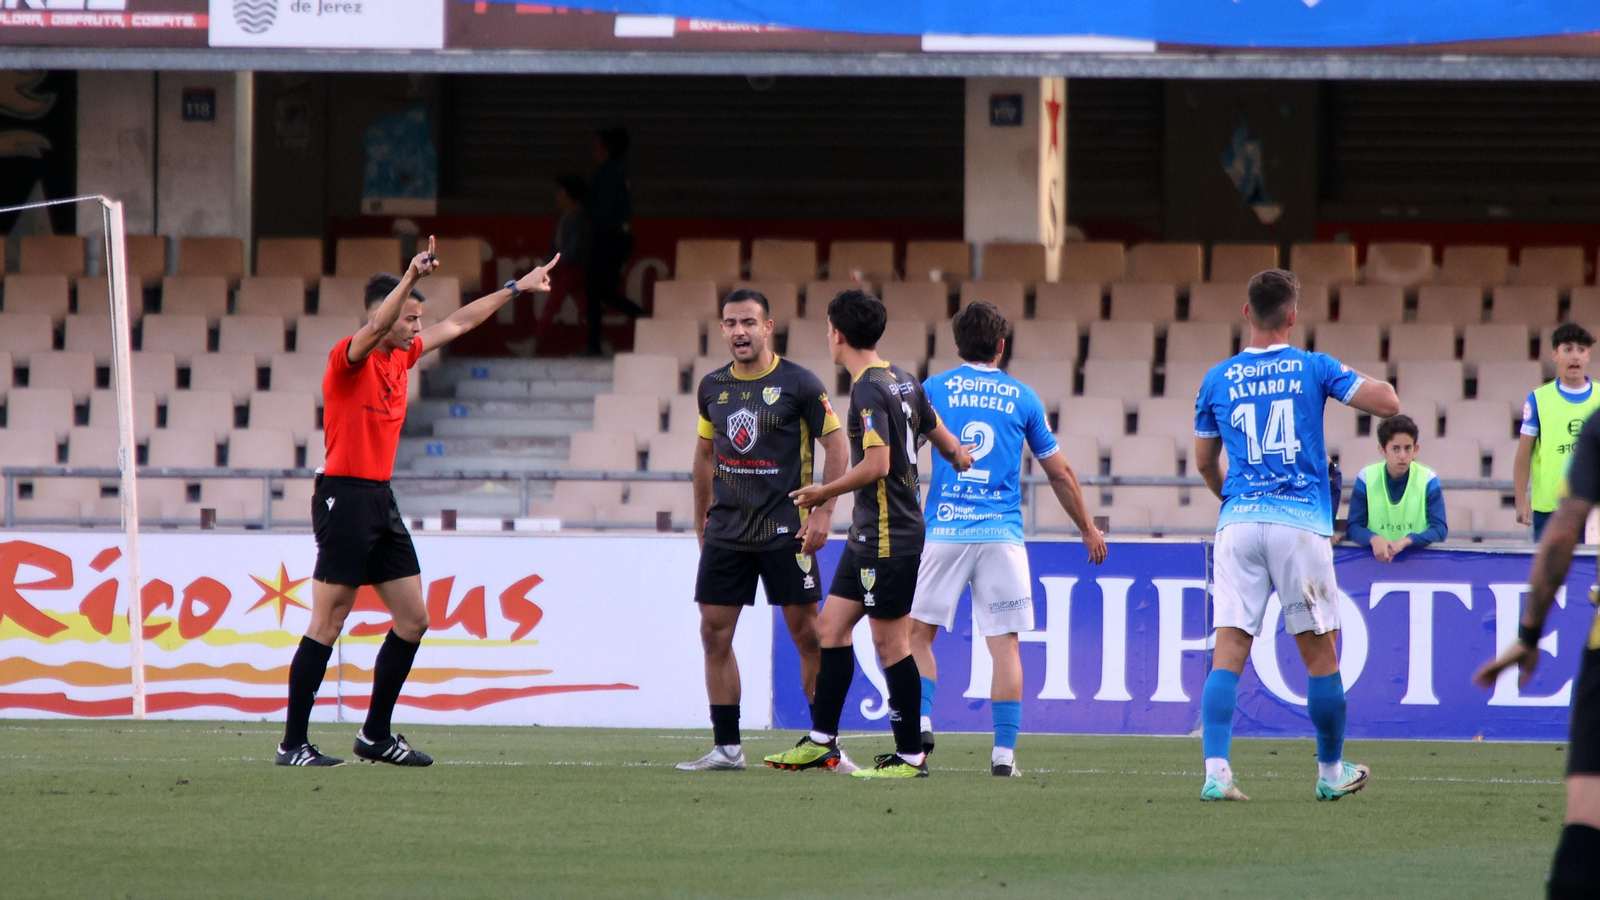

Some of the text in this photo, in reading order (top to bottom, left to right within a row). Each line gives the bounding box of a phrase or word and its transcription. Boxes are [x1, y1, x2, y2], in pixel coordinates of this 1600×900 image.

[290, 0, 363, 16] de Jerez
[1228, 378, 1303, 402] ALVARO M.
[947, 394, 1015, 415] MARCELO
[1230, 399, 1301, 465] 14
[957, 421, 994, 484] 2
[1232, 504, 1314, 519] XEREZ DEPORTIVO
[932, 526, 1009, 536] XEREZ DEPORTIVO
[962, 576, 1600, 708] HIPOTE
